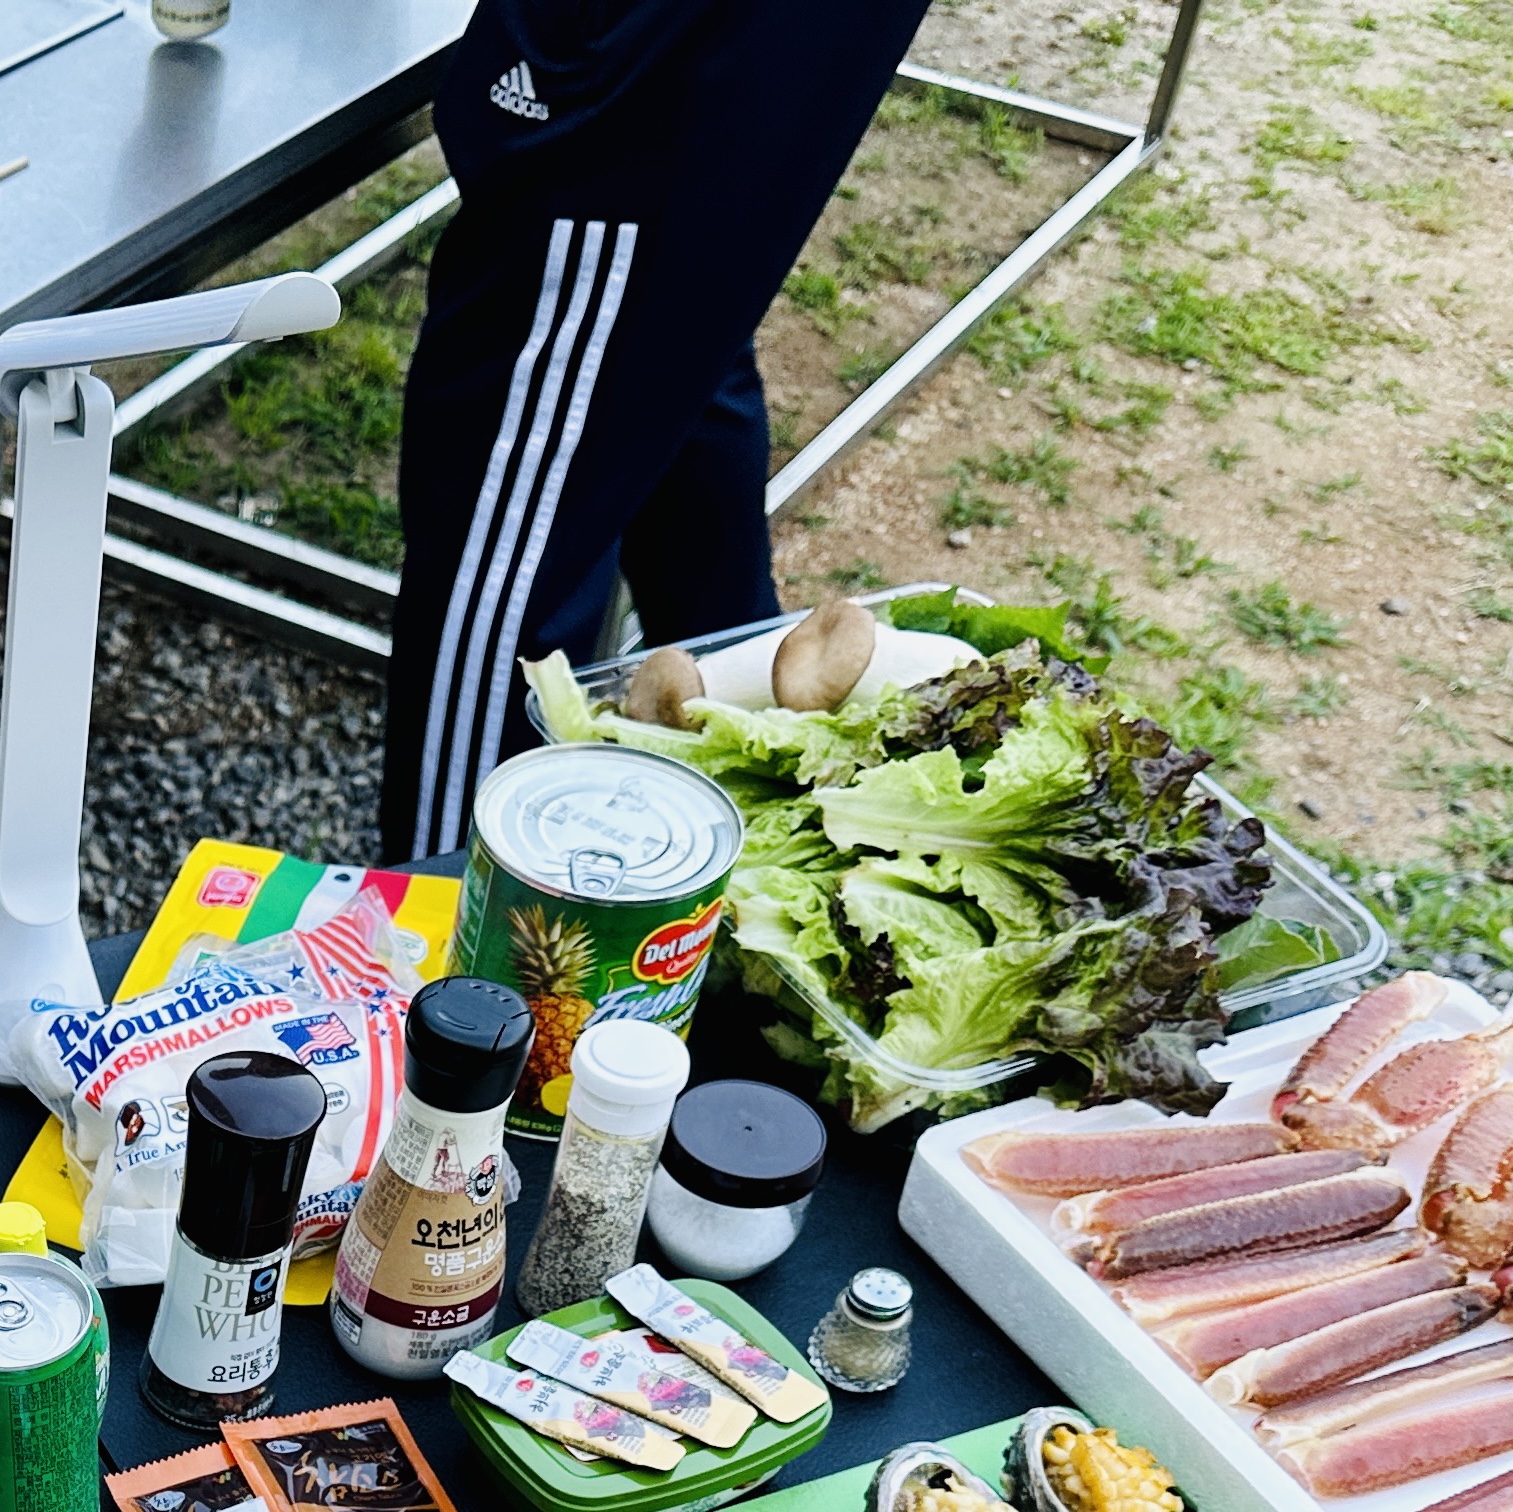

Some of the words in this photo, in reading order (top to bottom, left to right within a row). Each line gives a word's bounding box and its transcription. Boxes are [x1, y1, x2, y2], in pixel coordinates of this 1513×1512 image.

[490, 83, 549, 120] adidas
[643, 940, 677, 965] Del
[61, 978, 286, 1091] Mountain
[84, 998, 294, 1113] MARSHMALLOWS
[312, 1047, 358, 1064] U.S.A.
[125, 1146, 160, 1167] True
[410, 1202, 498, 1250] 오천년의
[423, 1230, 504, 1277] 명품구운소
[193, 1300, 280, 1343] WHO
[411, 1305, 470, 1328] 구운소금
